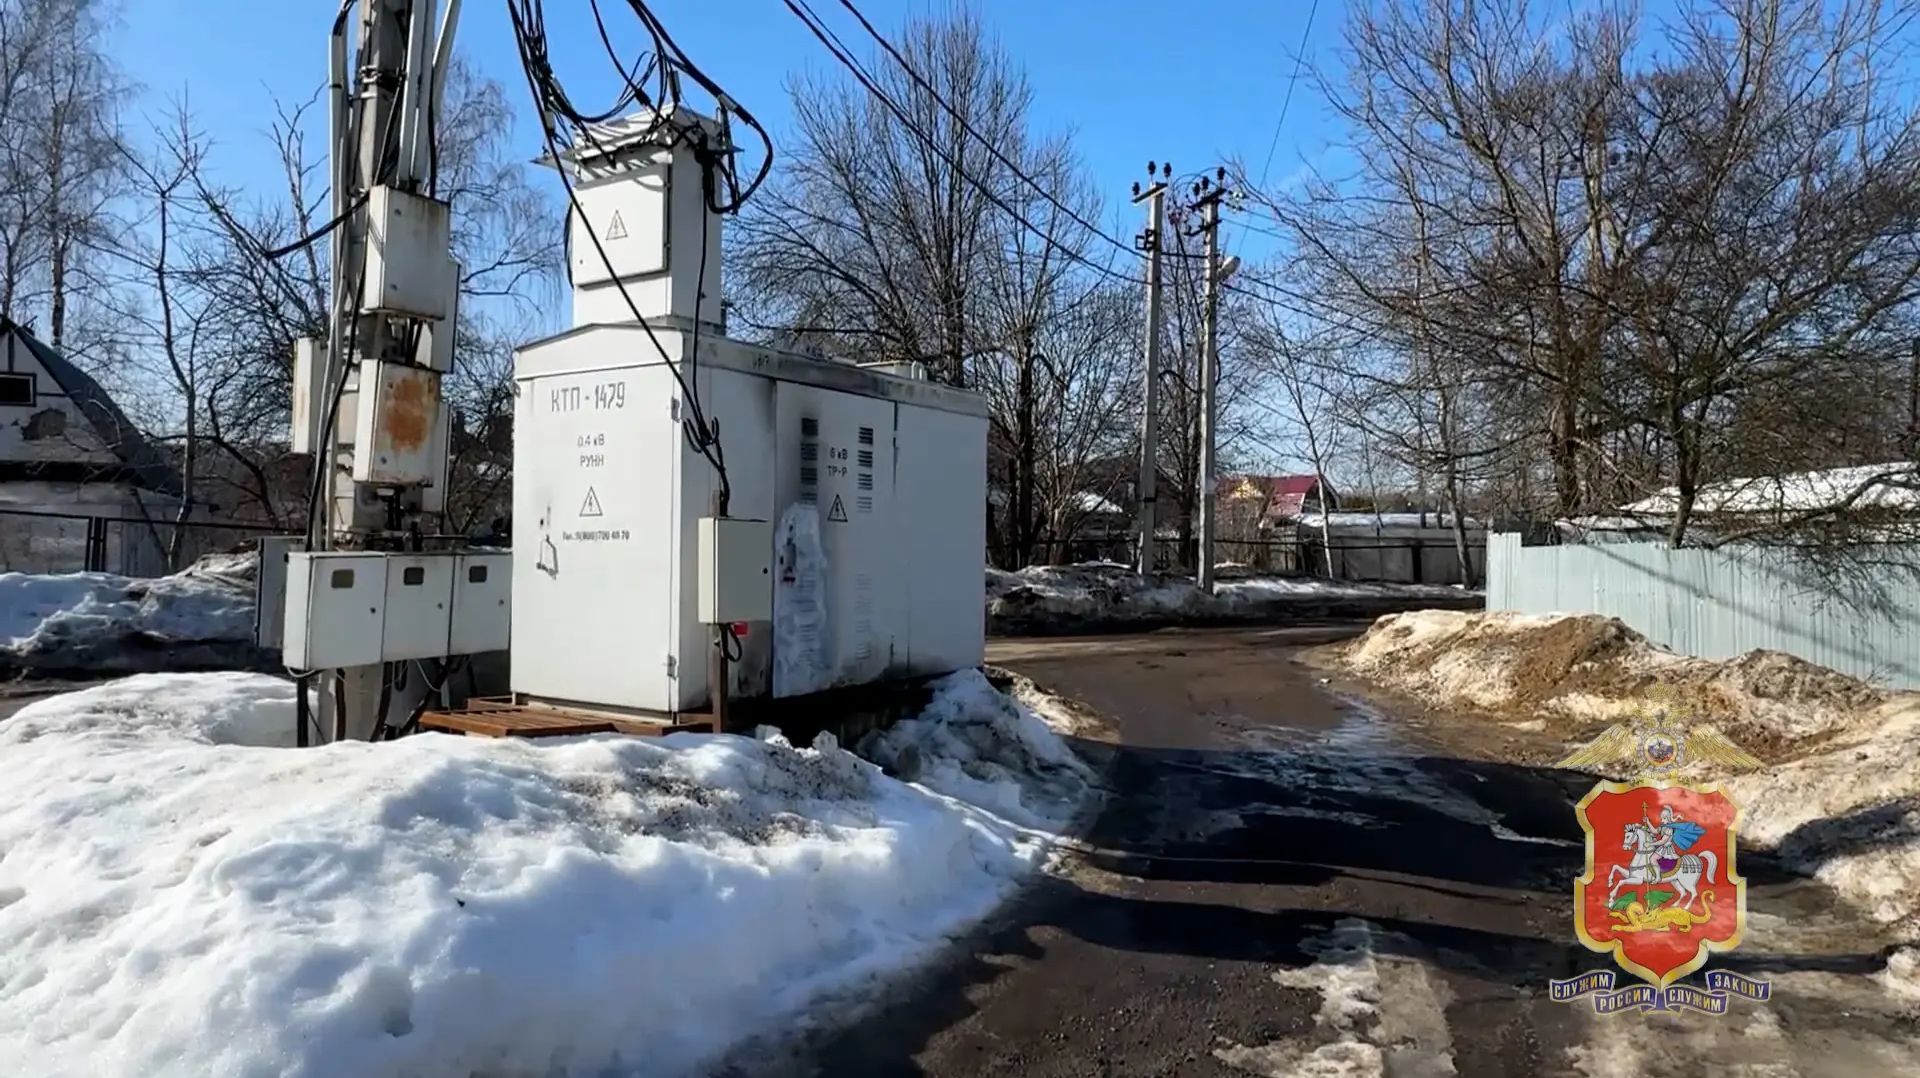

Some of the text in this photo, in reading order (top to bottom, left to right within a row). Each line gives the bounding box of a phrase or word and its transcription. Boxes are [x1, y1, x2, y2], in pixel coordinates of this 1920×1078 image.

[551, 386, 580, 412] КТП
[595, 381, 625, 409] 1479
[580, 454, 604, 467] РУНН
